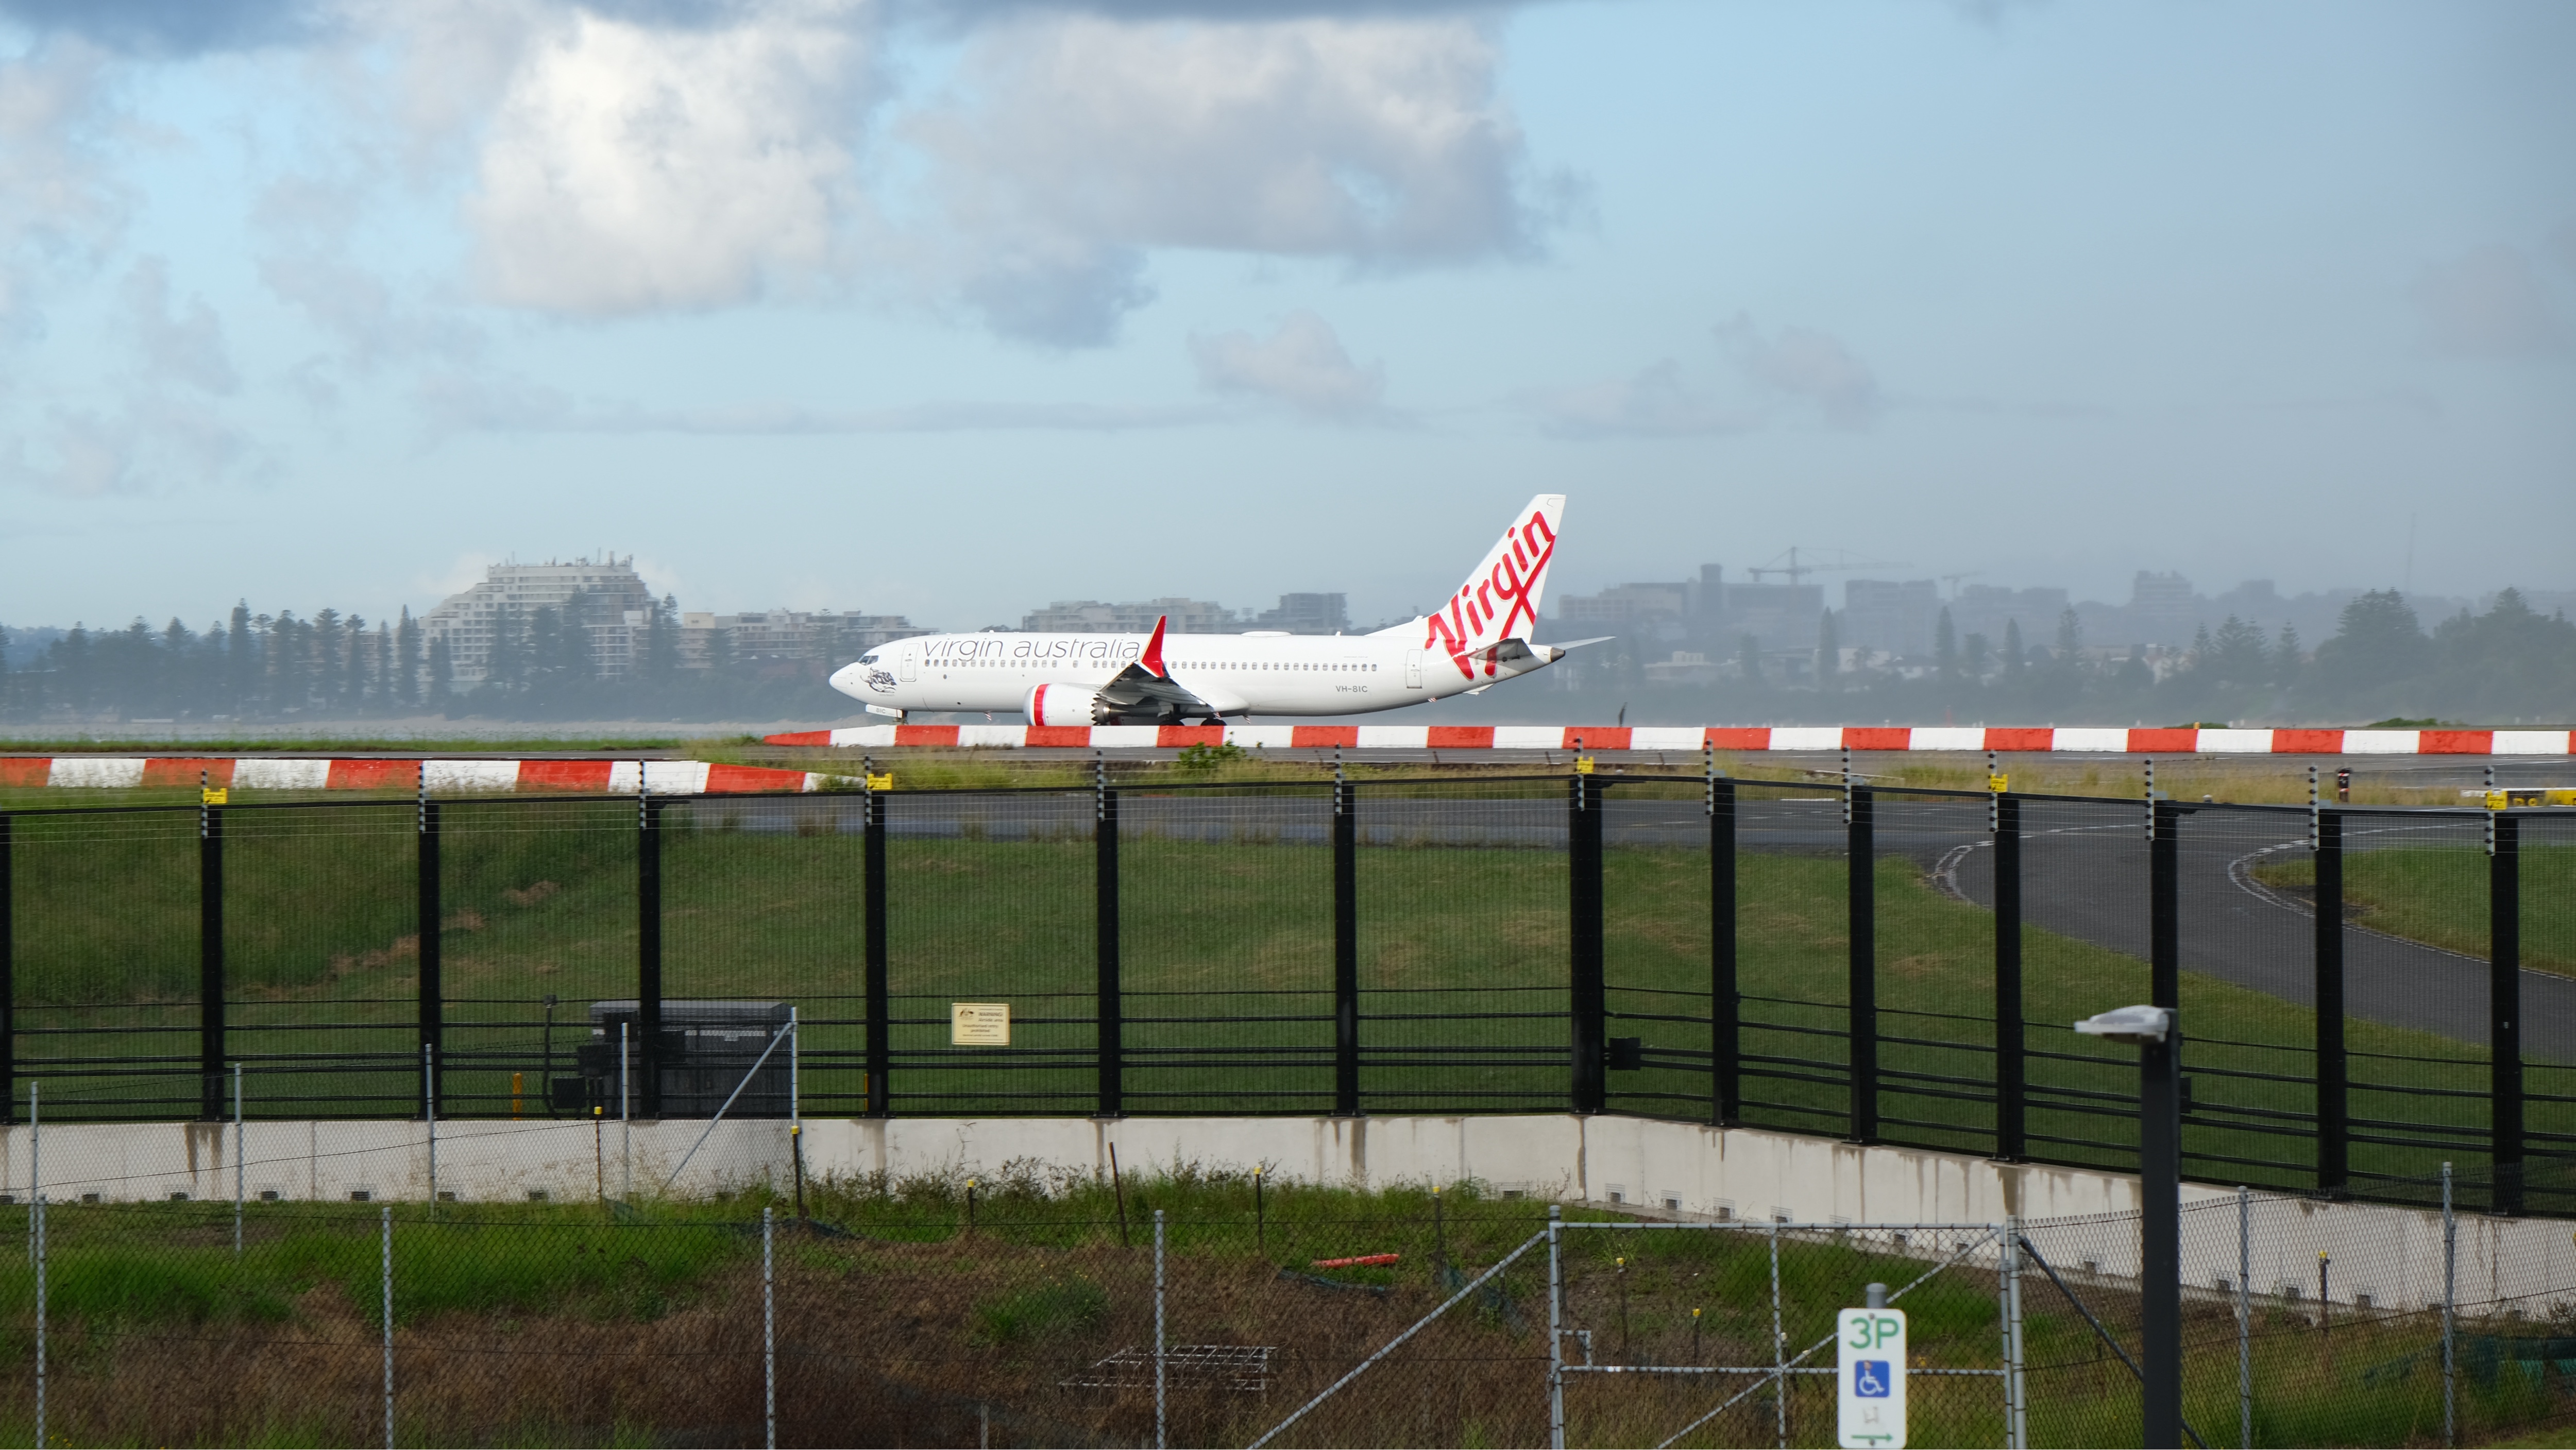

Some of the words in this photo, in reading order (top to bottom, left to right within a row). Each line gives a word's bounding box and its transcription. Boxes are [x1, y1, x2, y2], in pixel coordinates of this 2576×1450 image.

[1424, 510, 1556, 681] Virgin
[925, 638, 1003, 661] virgin
[1013, 639, 1140, 658] australia
[1849, 1317, 1900, 1349] 3P
